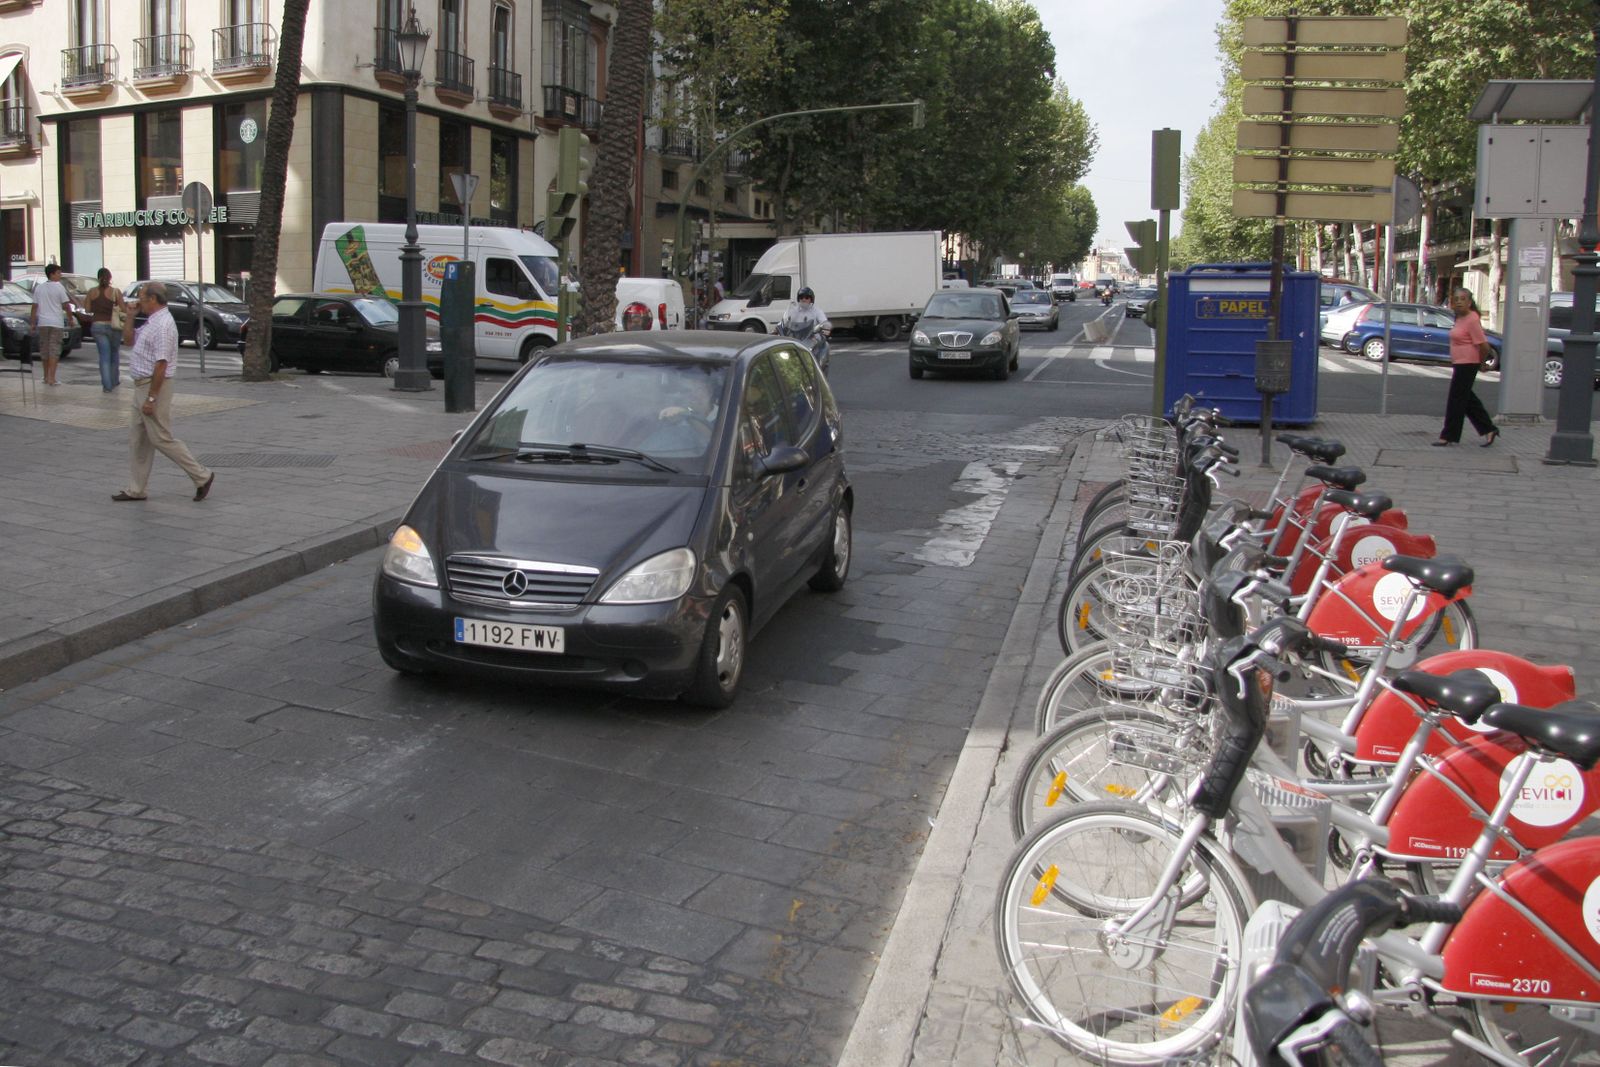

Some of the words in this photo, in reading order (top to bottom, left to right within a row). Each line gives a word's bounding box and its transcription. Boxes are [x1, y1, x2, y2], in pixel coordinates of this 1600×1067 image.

[76, 209, 165, 229] STARBUCKS
[167, 205, 228, 226] COEE
[448, 263, 456, 280] P
[1220, 301, 1265, 313] PAPEL
[470, 623, 514, 645] 1192
[521, 628, 558, 649] FWV
[1341, 637, 1360, 646] 1995
[1514, 787, 1572, 801] EVICI
[1512, 978, 1551, 994] 2370
